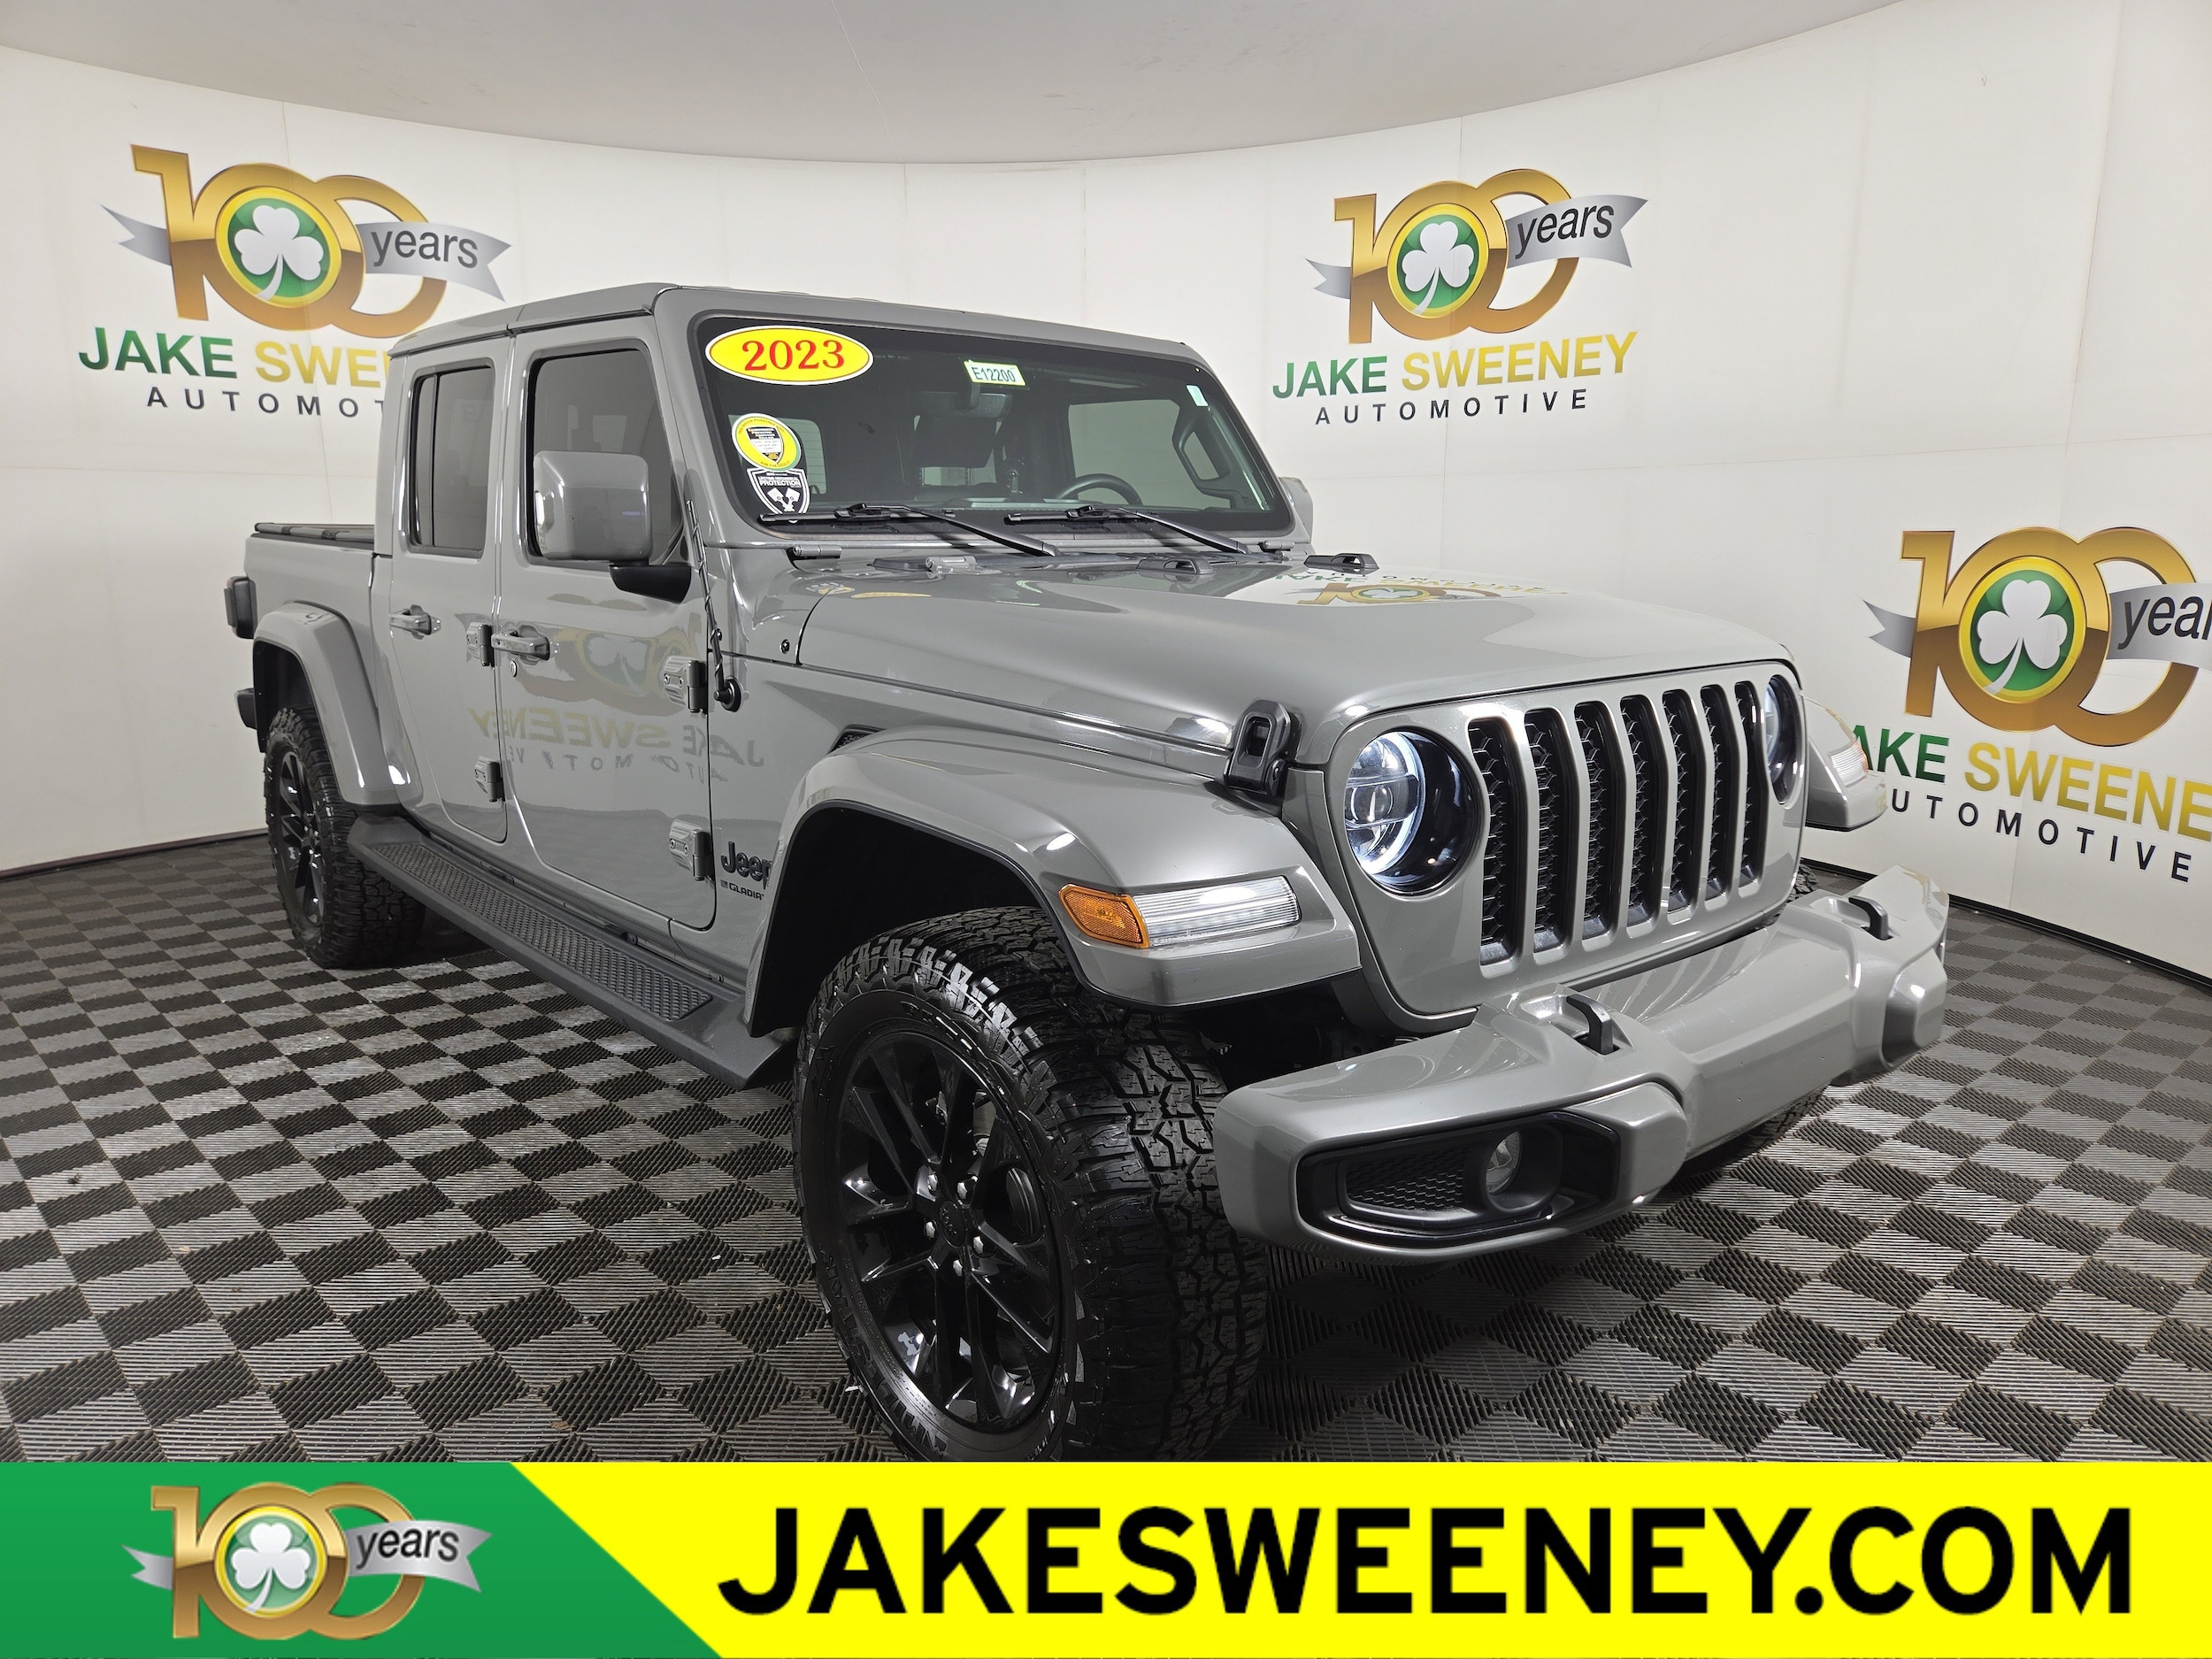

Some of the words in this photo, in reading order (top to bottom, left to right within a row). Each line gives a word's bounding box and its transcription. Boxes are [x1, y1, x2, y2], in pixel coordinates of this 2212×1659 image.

[131, 144, 447, 339] 100
[371, 229, 479, 268] years
[1333, 168, 1580, 344] 100
[1515, 204, 1614, 259] years
[79, 326, 238, 379] JAKE
[255, 341, 390, 388] SWE
[741, 340, 845, 372] 2023
[971, 366, 1017, 382] E12200
[1272, 356, 1387, 398] JAKE
[1402, 331, 1638, 391] SWEENEY
[1315, 388, 1586, 425] AUTOMOTIVE
[1901, 526, 2200, 748] 100
[1854, 725, 1950, 784] AKE
[1964, 741, 2212, 843] SWEENE
[1892, 788, 2193, 883] UTOMOTIVE
